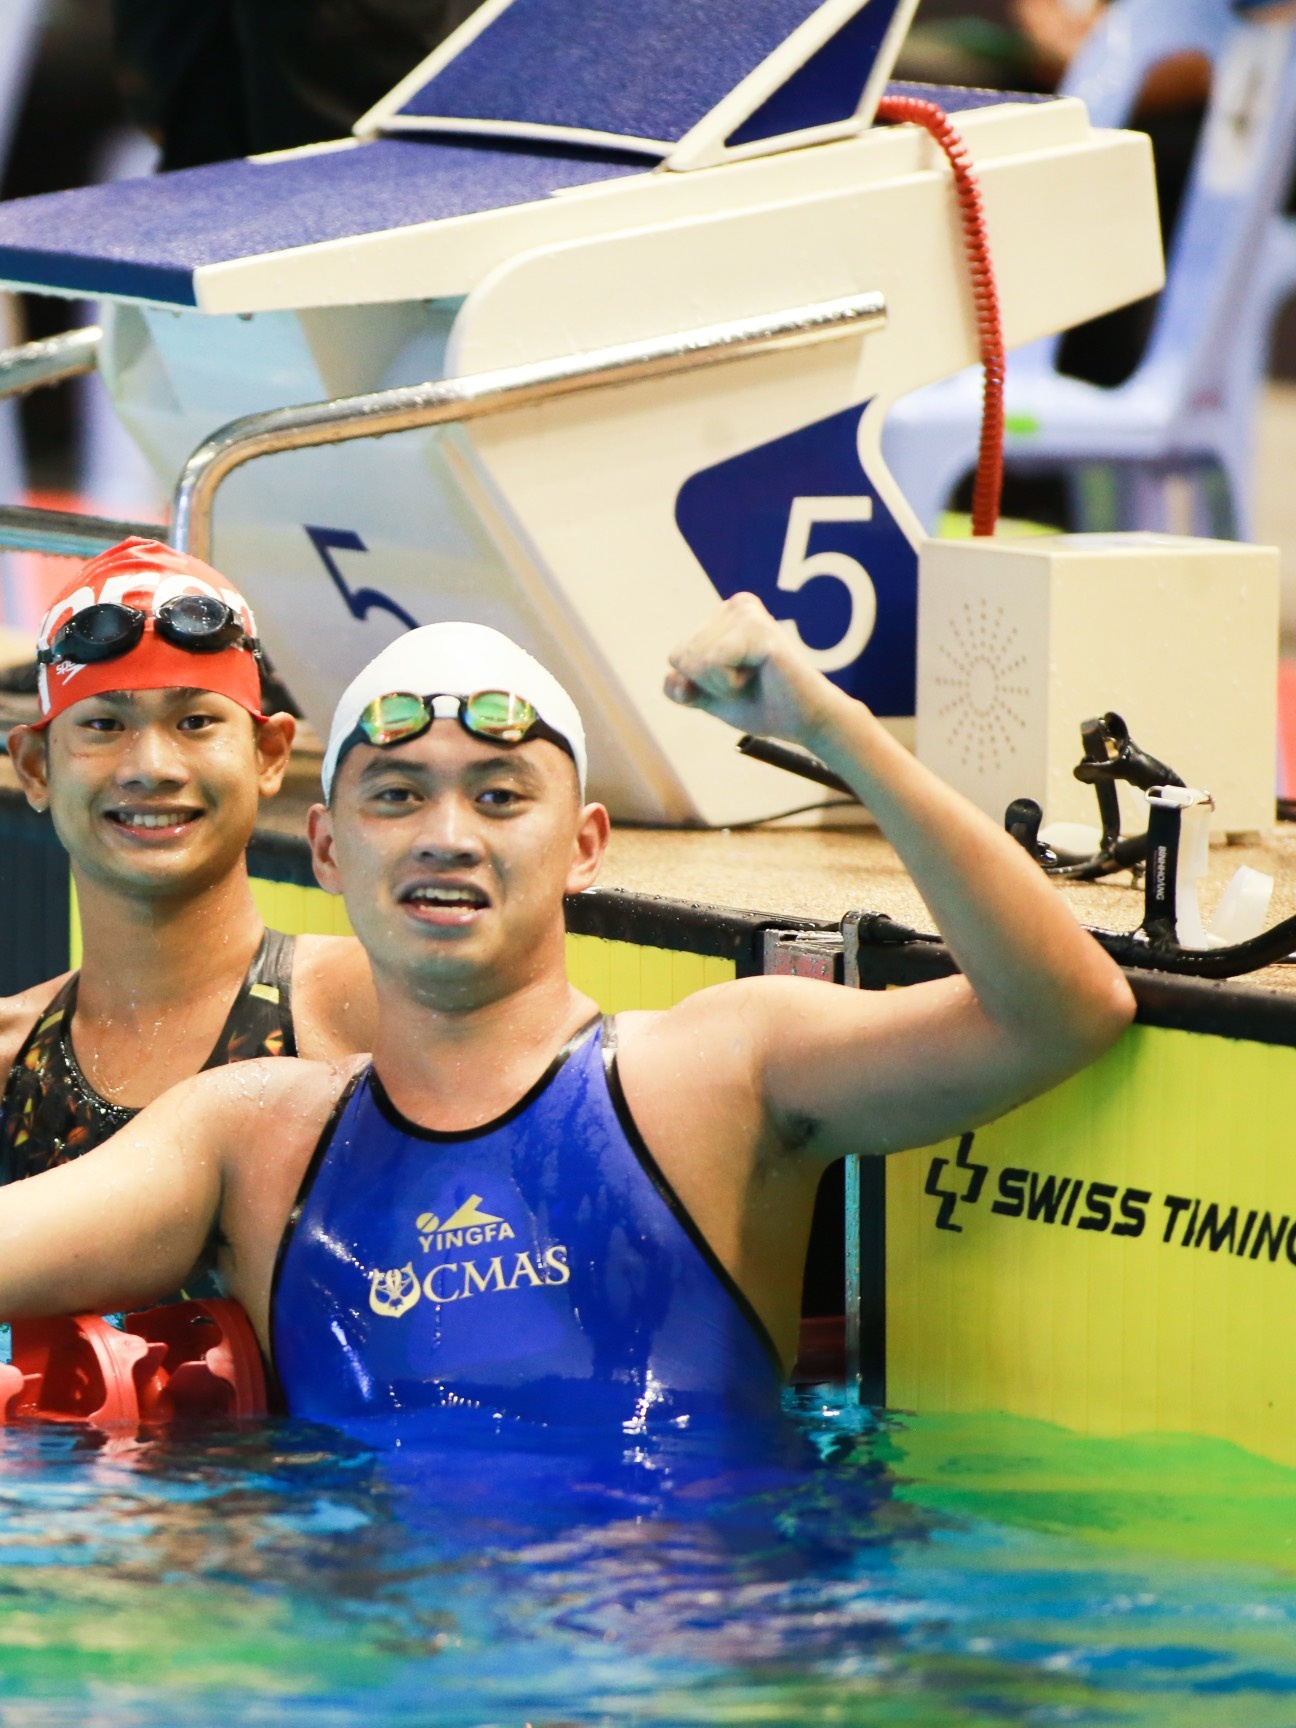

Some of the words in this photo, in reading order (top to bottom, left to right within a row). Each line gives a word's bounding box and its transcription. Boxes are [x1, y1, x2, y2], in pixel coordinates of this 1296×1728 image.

[777, 496, 876, 672] 5
[991, 1167, 1152, 1237] SWISS
[419, 1223, 515, 1252] YINGFA
[423, 1246, 570, 1303] CMAS
